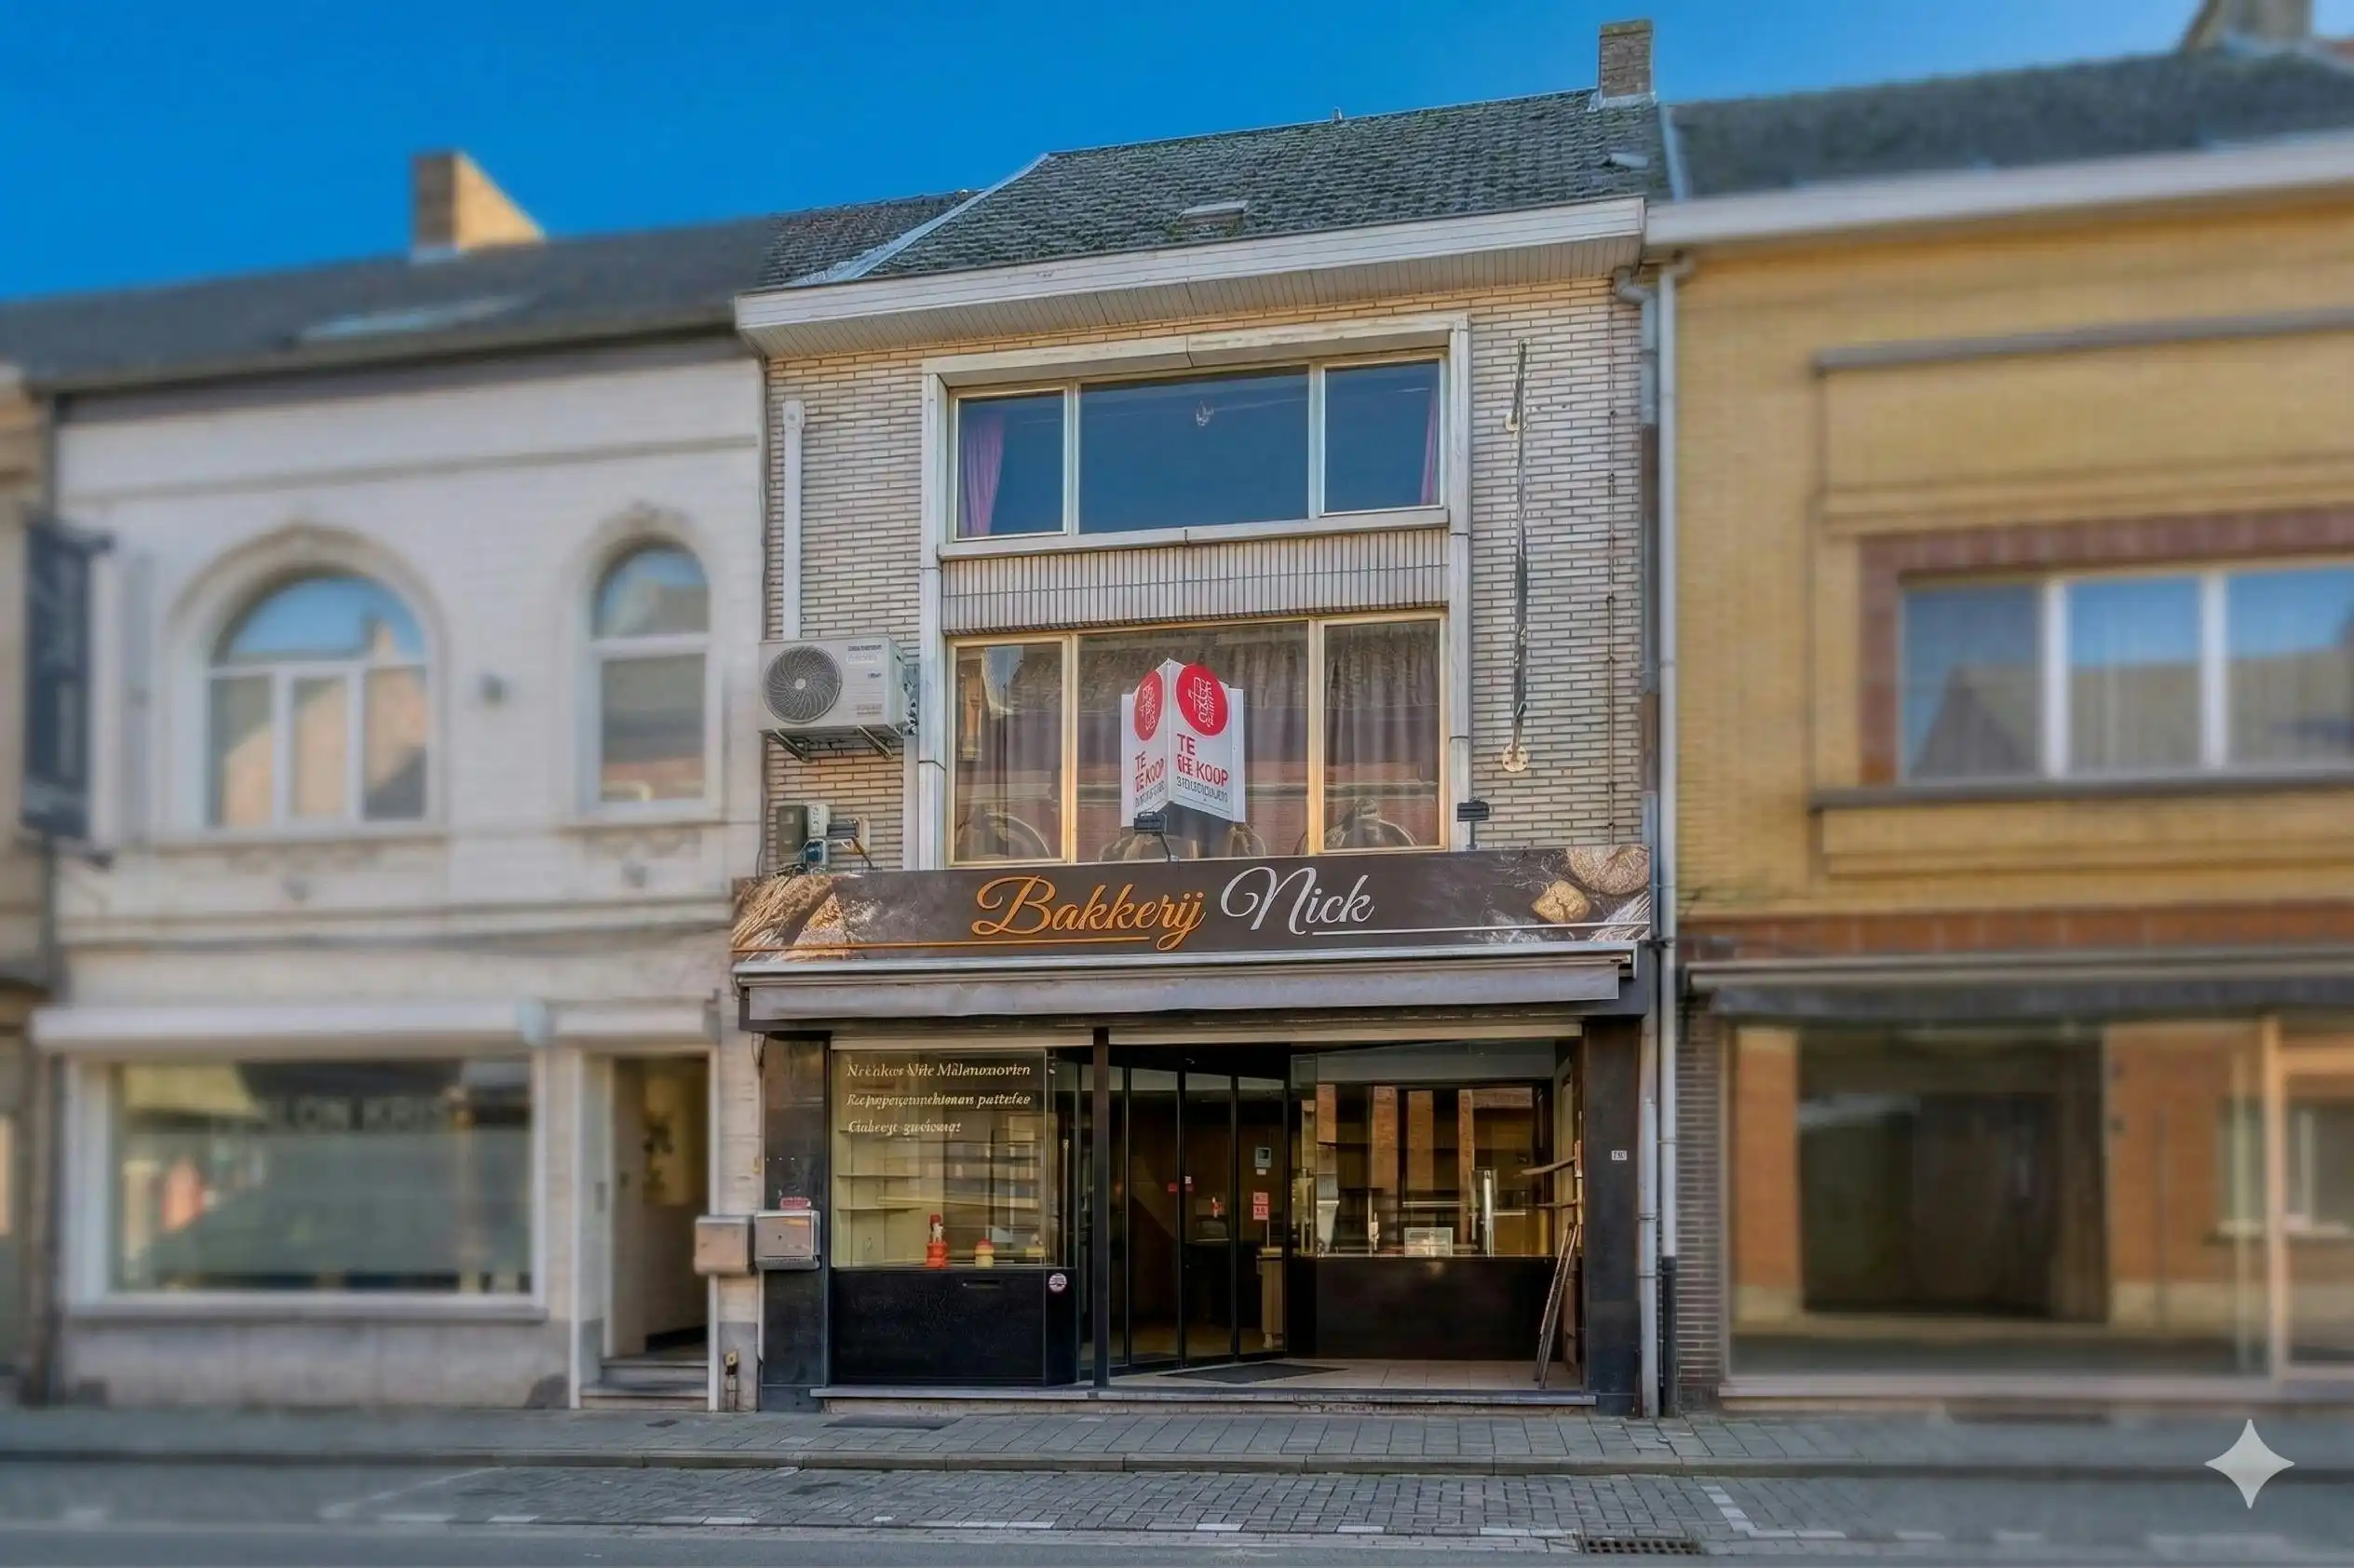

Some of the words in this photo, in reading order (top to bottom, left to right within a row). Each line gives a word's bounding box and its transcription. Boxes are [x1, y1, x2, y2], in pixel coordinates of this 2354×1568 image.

[1177, 733, 1196, 756] TE
[1135, 750, 1146, 773] TE
[1197, 760, 1229, 788] KOOP
[971, 874, 1206, 951] Bakkerij
[1221, 866, 1375, 936] Nick
